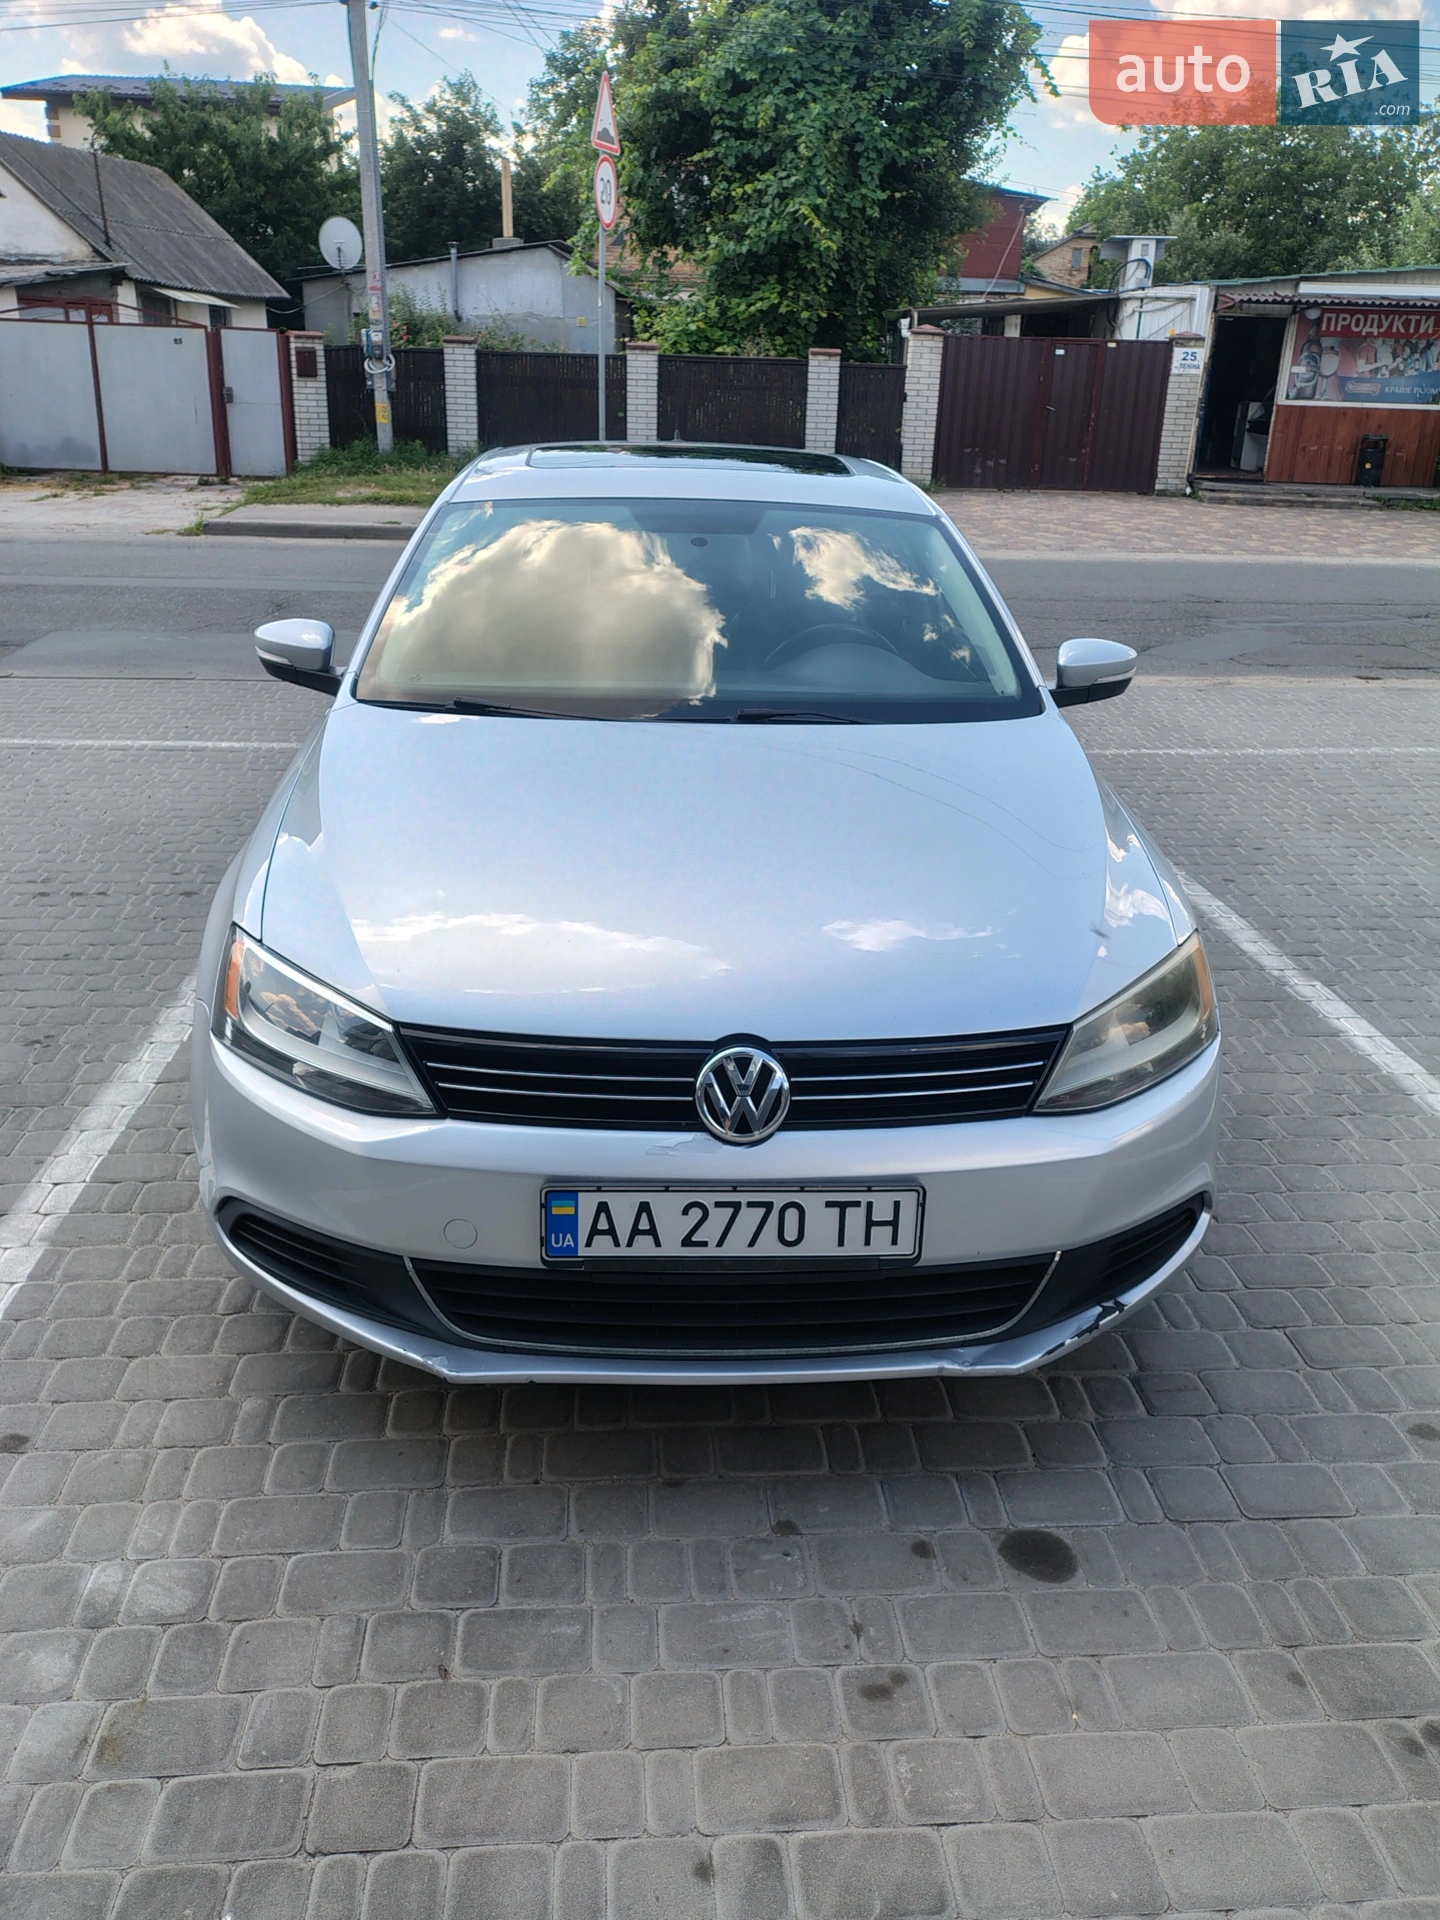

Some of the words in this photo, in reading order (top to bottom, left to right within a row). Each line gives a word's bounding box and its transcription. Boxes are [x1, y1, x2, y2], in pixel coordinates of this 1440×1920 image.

[600, 176, 612, 205] 20
[1321, 312, 1436, 336] ПРОДУКТИ
[1181, 351, 1197, 362] 25
[584, 1201, 662, 1248] AA
[681, 1201, 806, 1248] 2770
[825, 1201, 900, 1248] TH
[551, 1233, 575, 1248] UA
